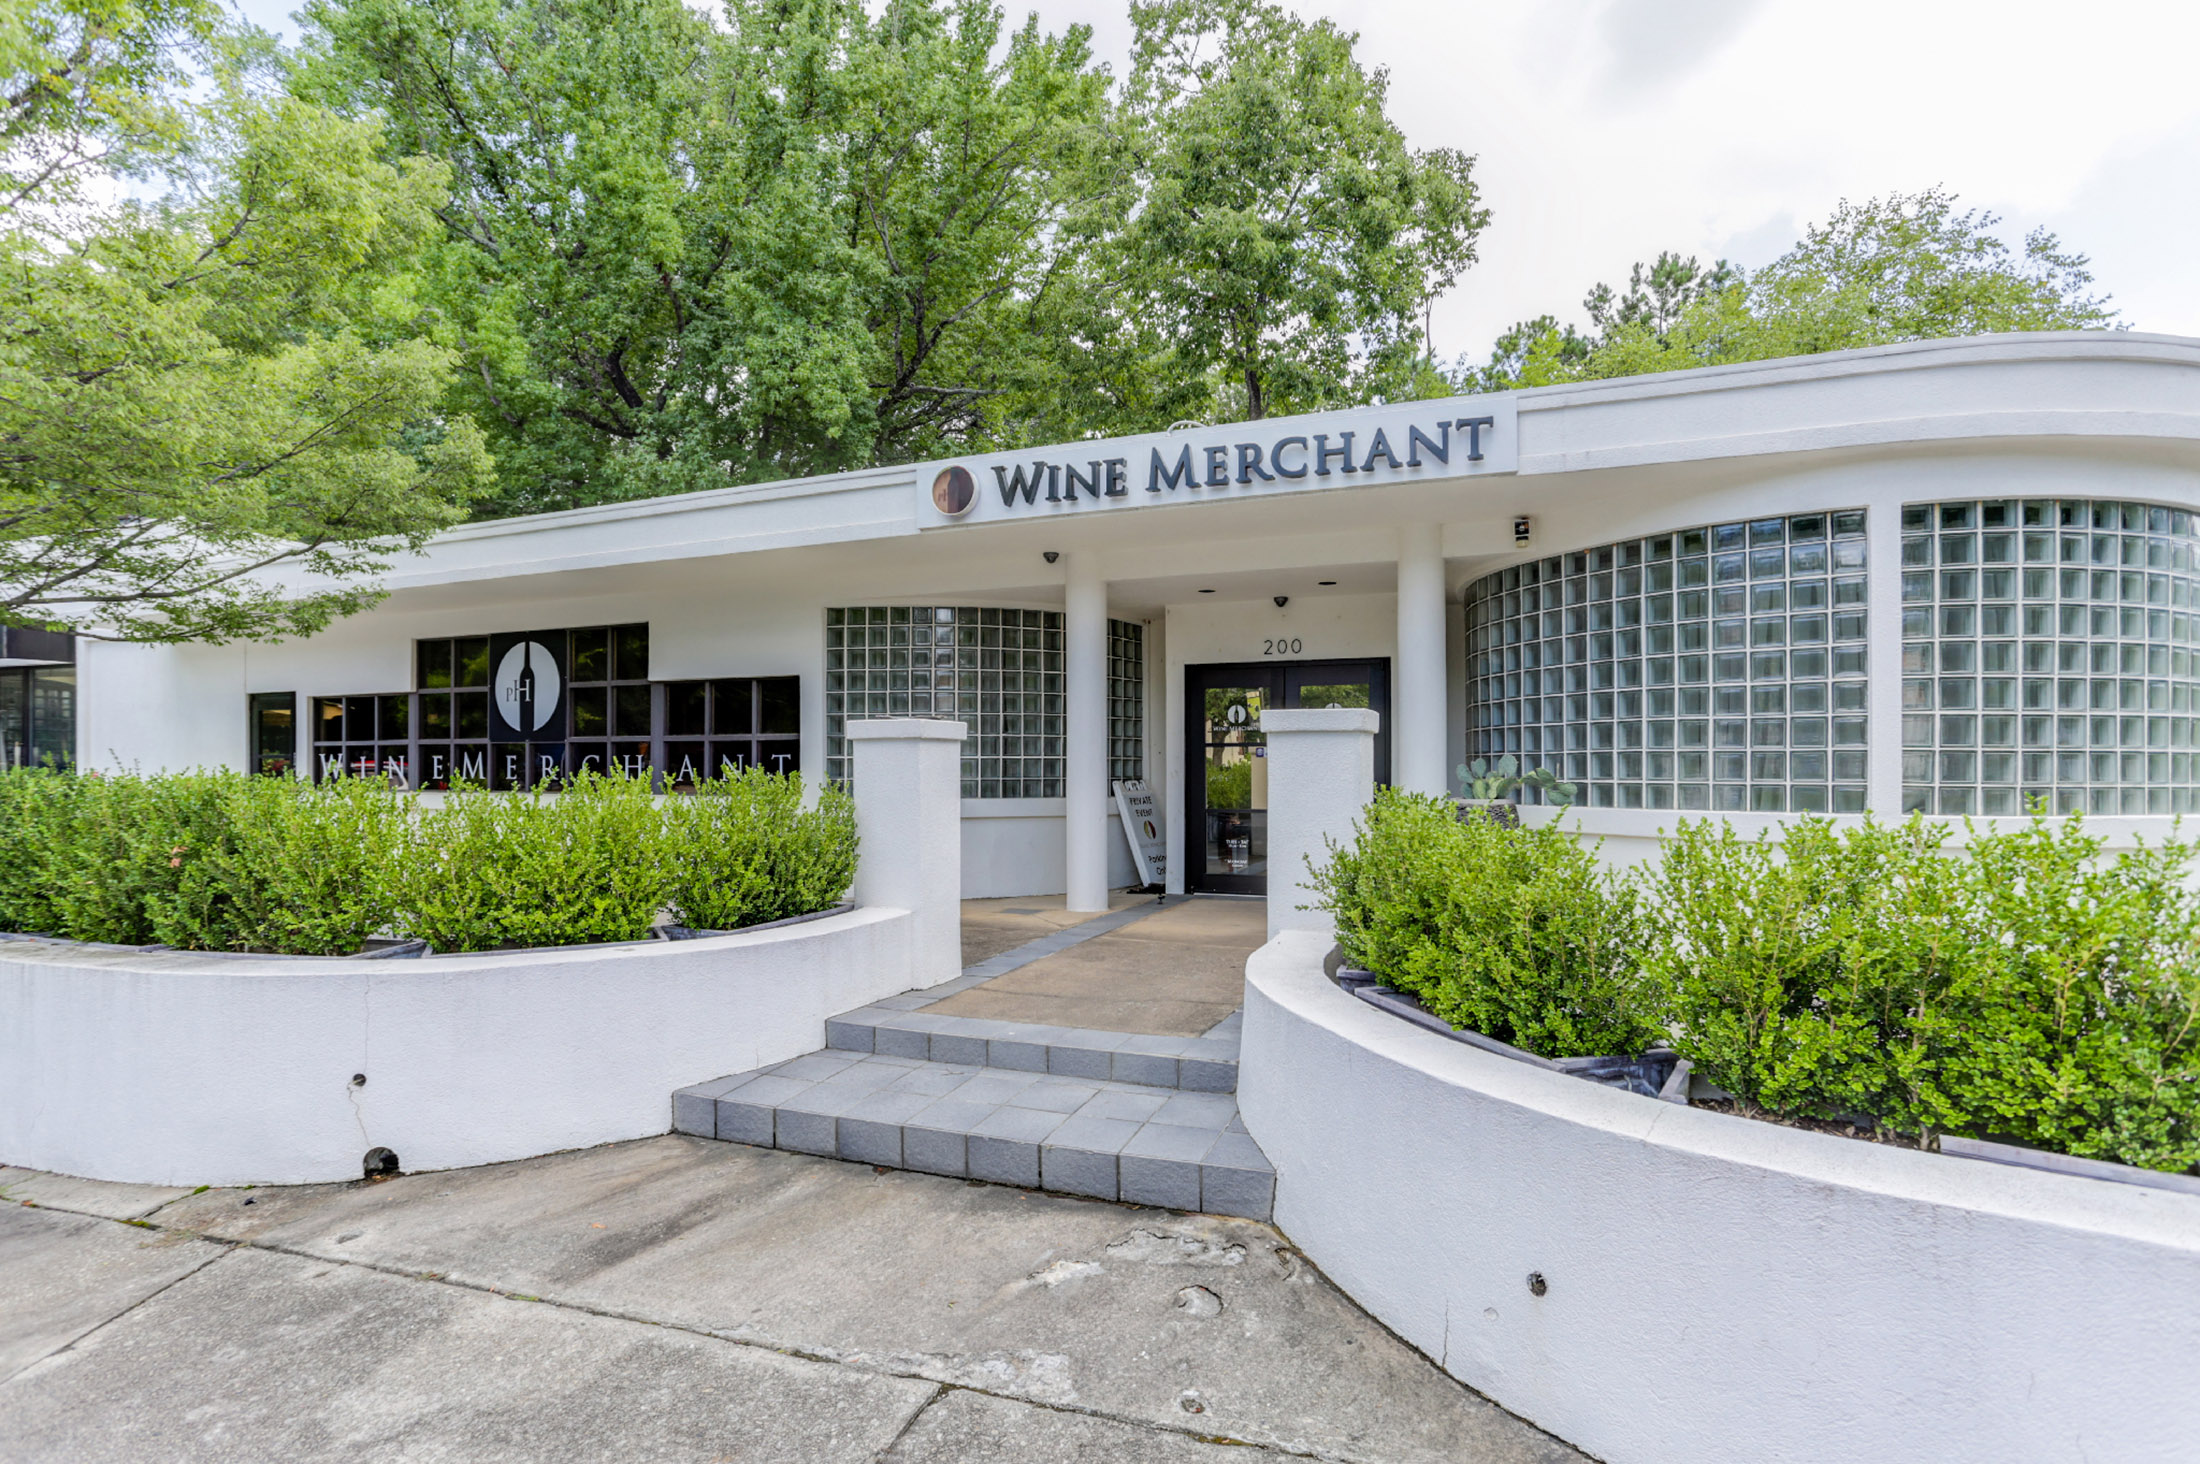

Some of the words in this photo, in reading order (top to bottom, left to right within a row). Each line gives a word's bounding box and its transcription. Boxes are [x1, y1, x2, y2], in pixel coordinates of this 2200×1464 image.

[991, 457, 1130, 508] WINE
[1145, 415, 1495, 494] MERCHANT
[1264, 638, 1302, 655] 200
